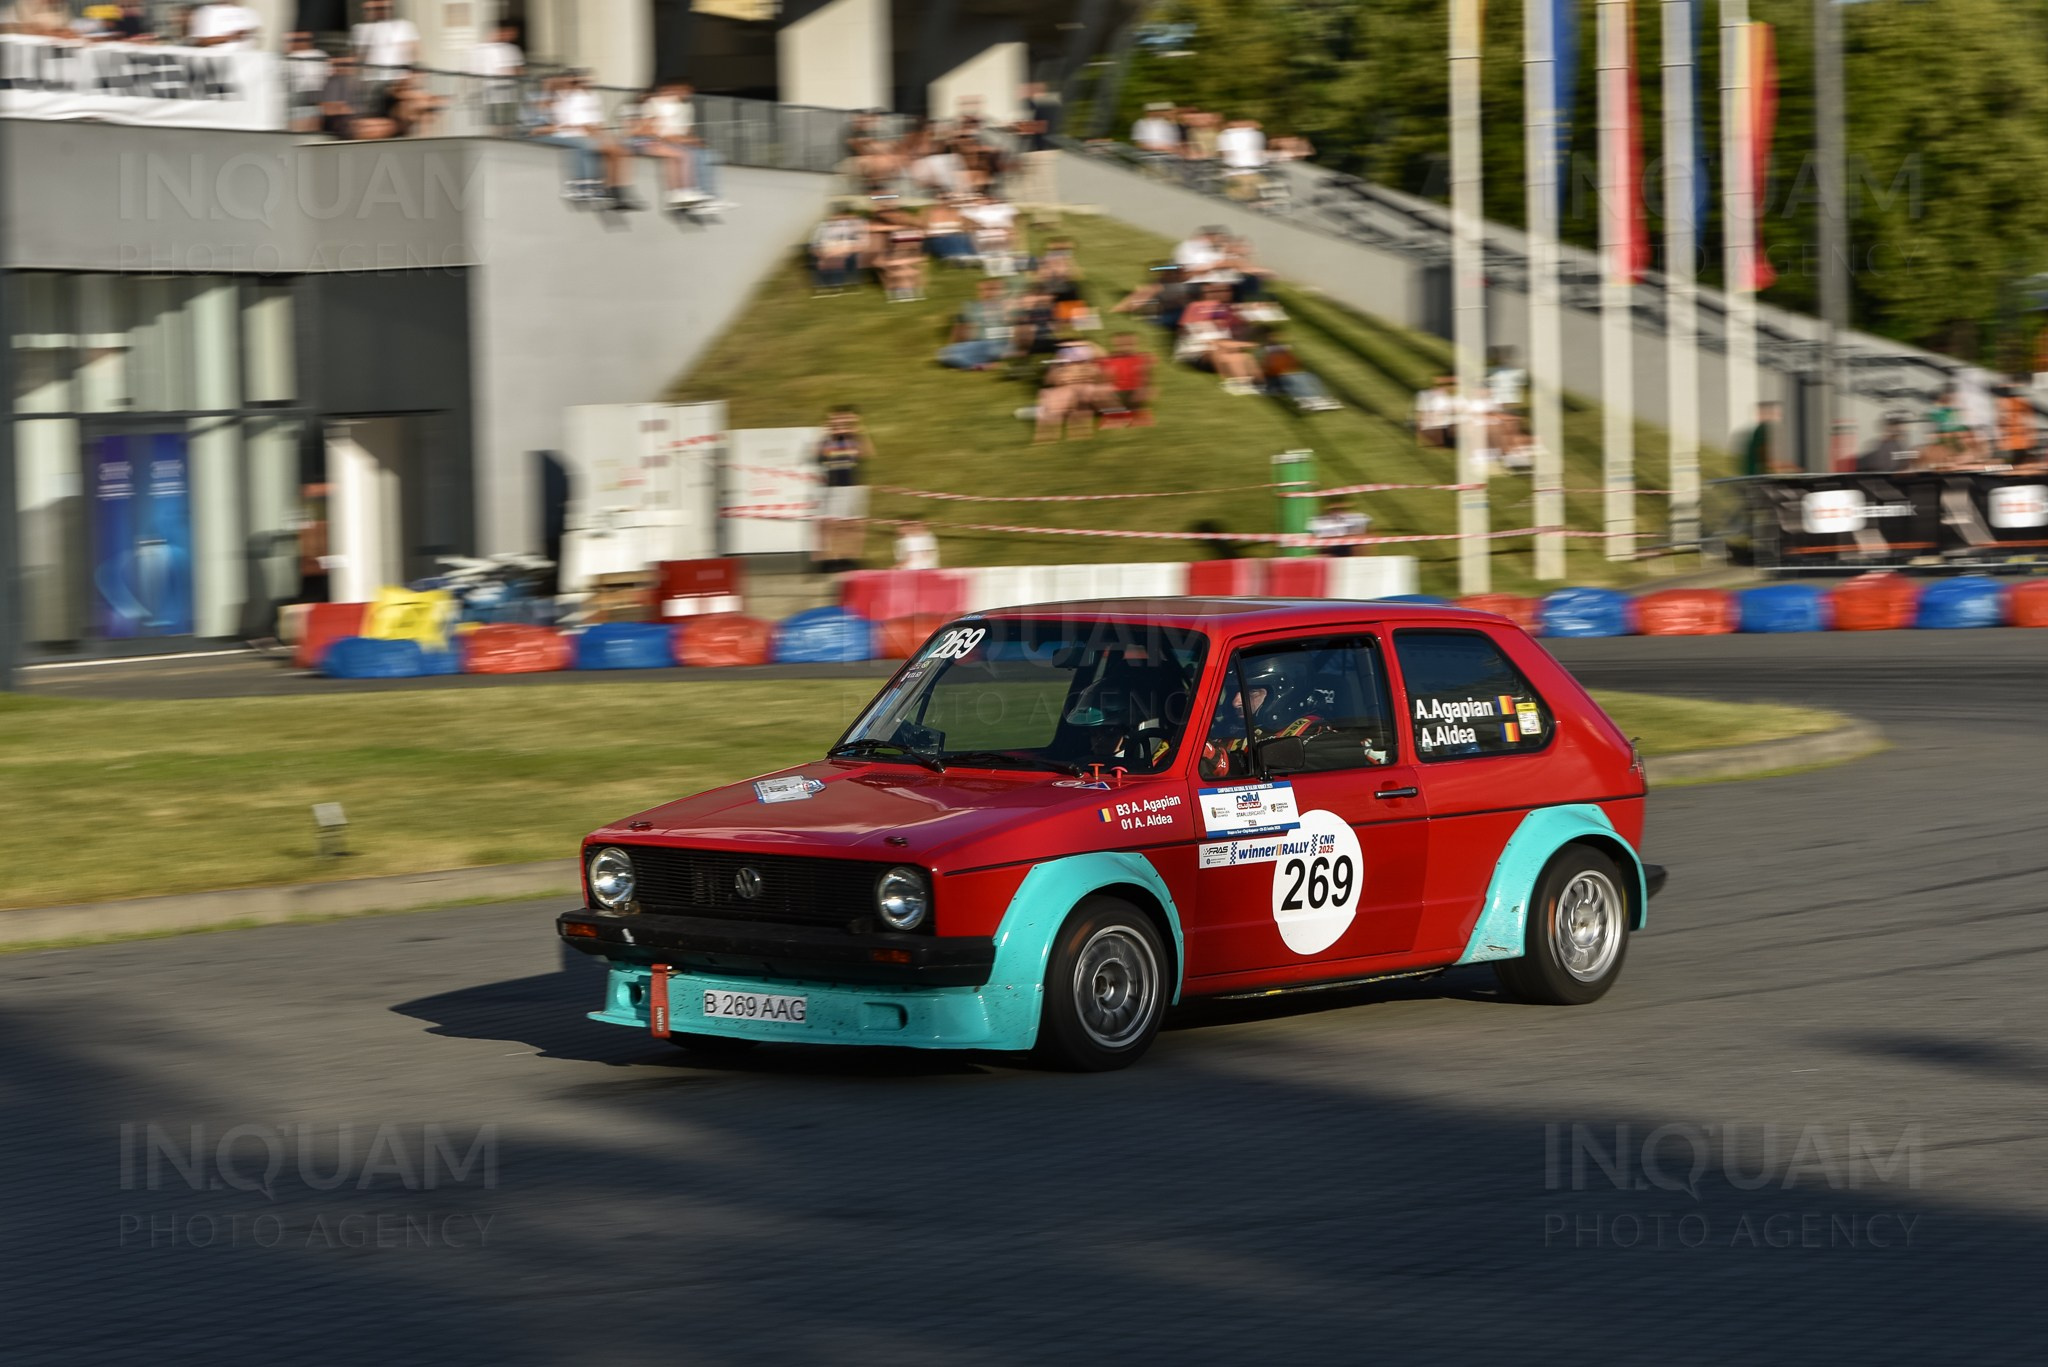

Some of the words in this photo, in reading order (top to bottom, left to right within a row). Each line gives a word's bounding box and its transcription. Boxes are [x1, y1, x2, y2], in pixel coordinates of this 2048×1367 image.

[929, 627, 985, 659] 269
[1416, 697, 1494, 723] A.Agapian
[1421, 725, 1476, 747] A.Aldea
[1116, 803, 1130, 816] B3
[1132, 801, 1142, 813] A.
[1143, 795, 1181, 812] Agapian
[1121, 818, 1133, 830] 01
[1135, 817, 1145, 828] A.
[1147, 814, 1173, 827] Aldea
[1318, 845, 1334, 854] 2025
[1319, 834, 1335, 844] CNR
[1281, 855, 1353, 910] 269
[705, 993, 717, 1013] B
[723, 994, 757, 1016] 269
[759, 997, 807, 1021] AAG
